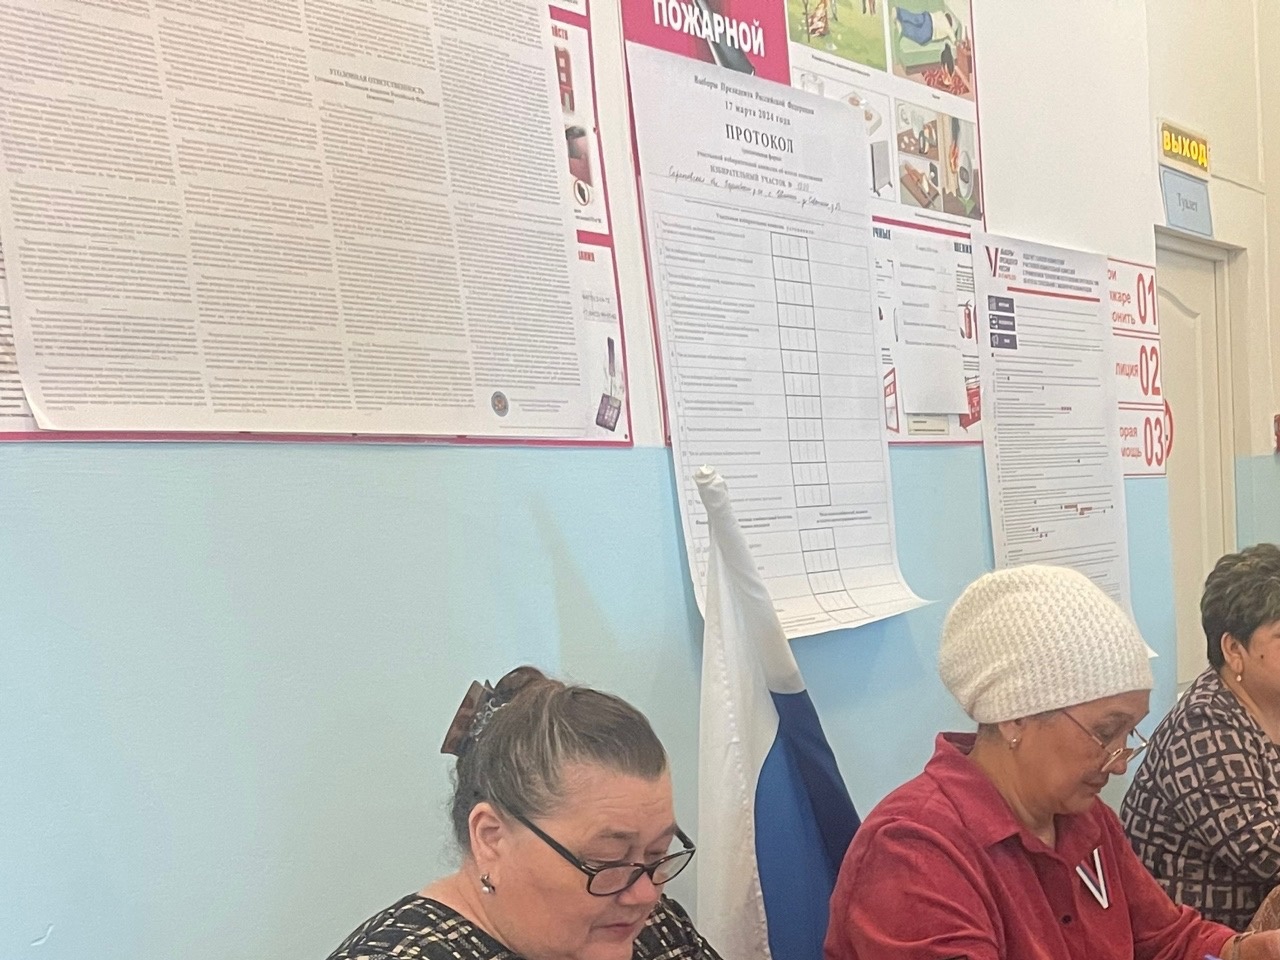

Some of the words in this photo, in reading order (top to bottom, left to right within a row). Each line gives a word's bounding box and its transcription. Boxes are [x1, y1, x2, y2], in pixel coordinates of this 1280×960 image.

[653, 0, 766, 57] ПОЖАРНОЙ
[725, 101, 734, 112] 17
[735, 105, 756, 118] марта
[758, 109, 775, 122] 2024
[775, 115, 791, 126] года
[725, 123, 794, 154] ПРОТОКОЛ
[1163, 130, 1208, 168] ВЫХОД
[1136, 273, 1157, 326] 01
[1139, 345, 1161, 396] 02
[1143, 416, 1164, 467] 03
